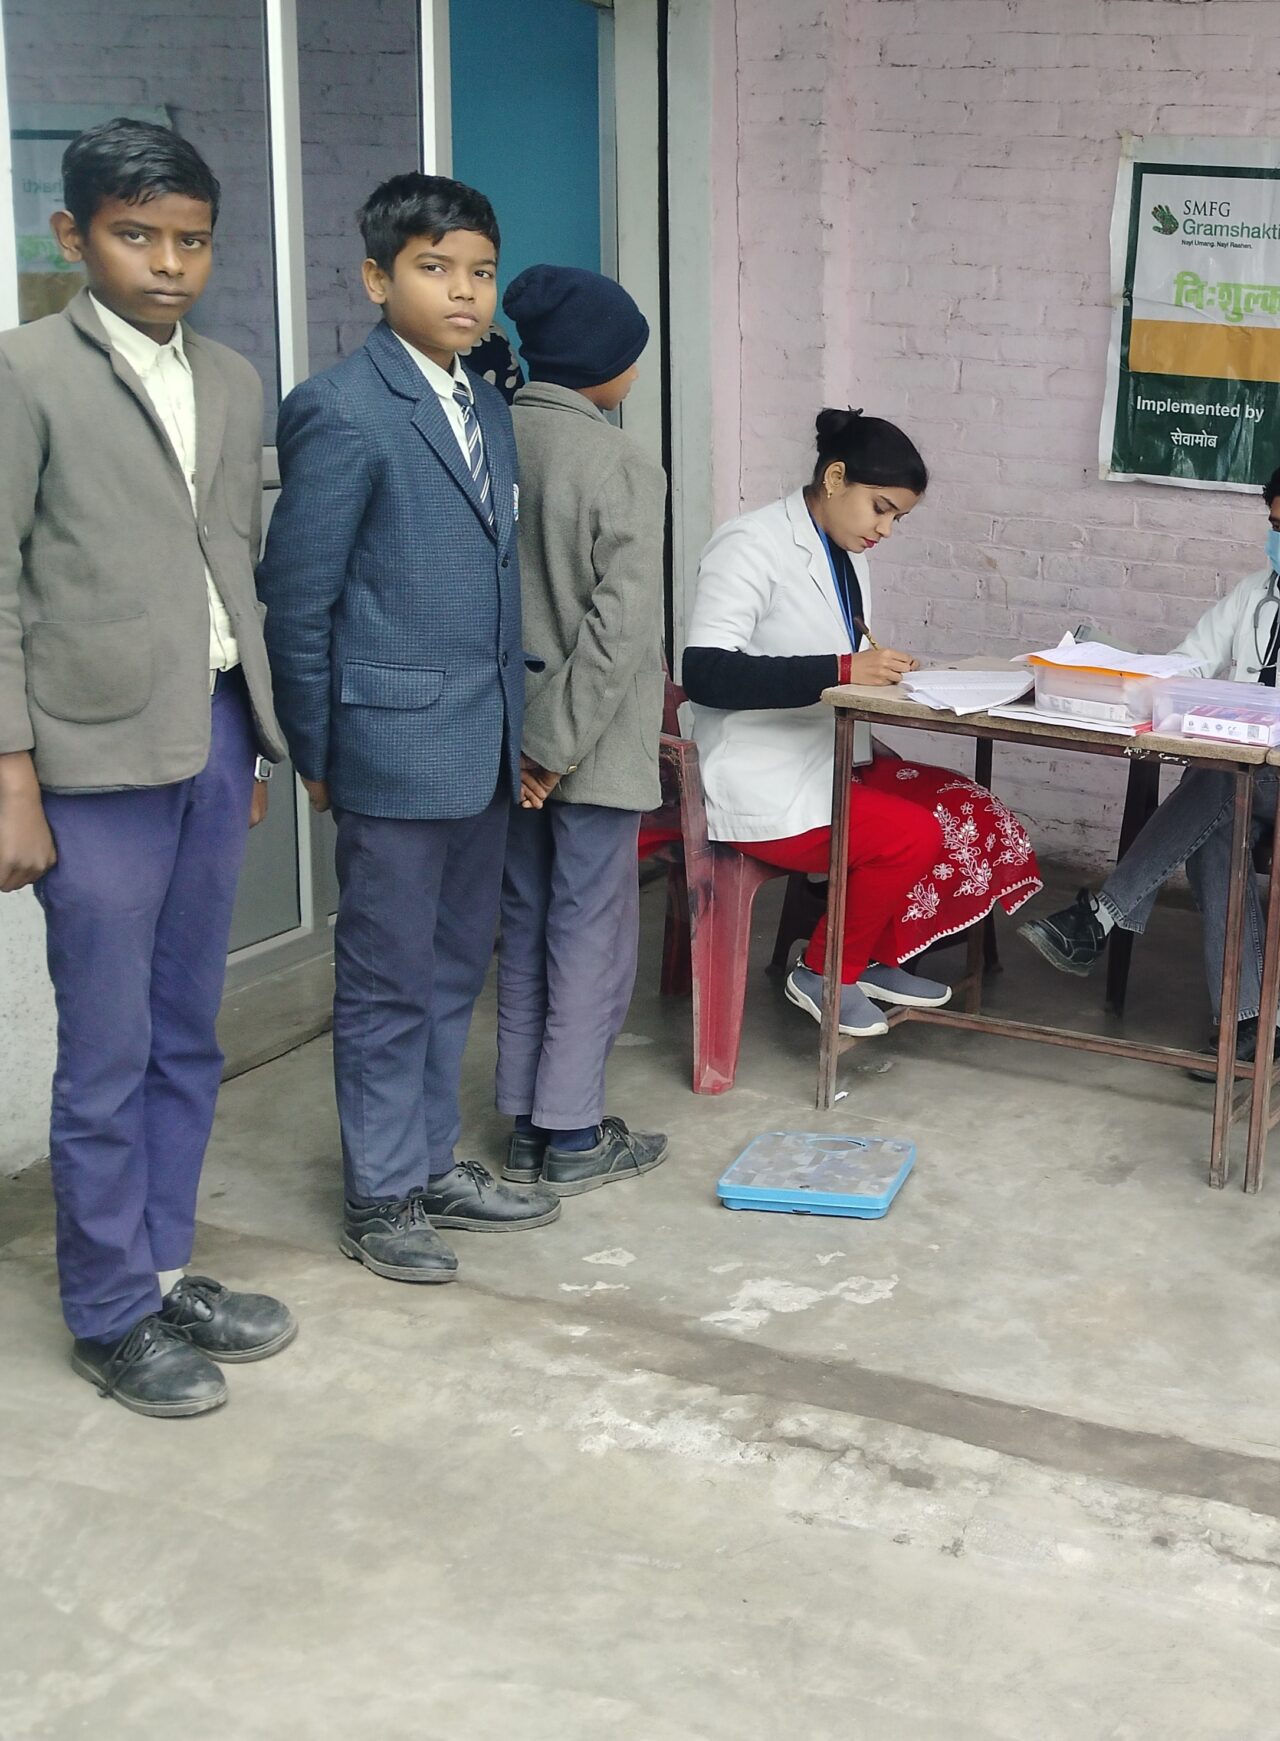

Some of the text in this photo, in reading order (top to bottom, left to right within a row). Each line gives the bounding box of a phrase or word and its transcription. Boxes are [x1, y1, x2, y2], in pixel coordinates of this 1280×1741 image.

[1183, 199, 1231, 218] SMFG
[1136, 395, 1265, 422] Implemented by
[1170, 427, 1218, 448] सेवामोब
